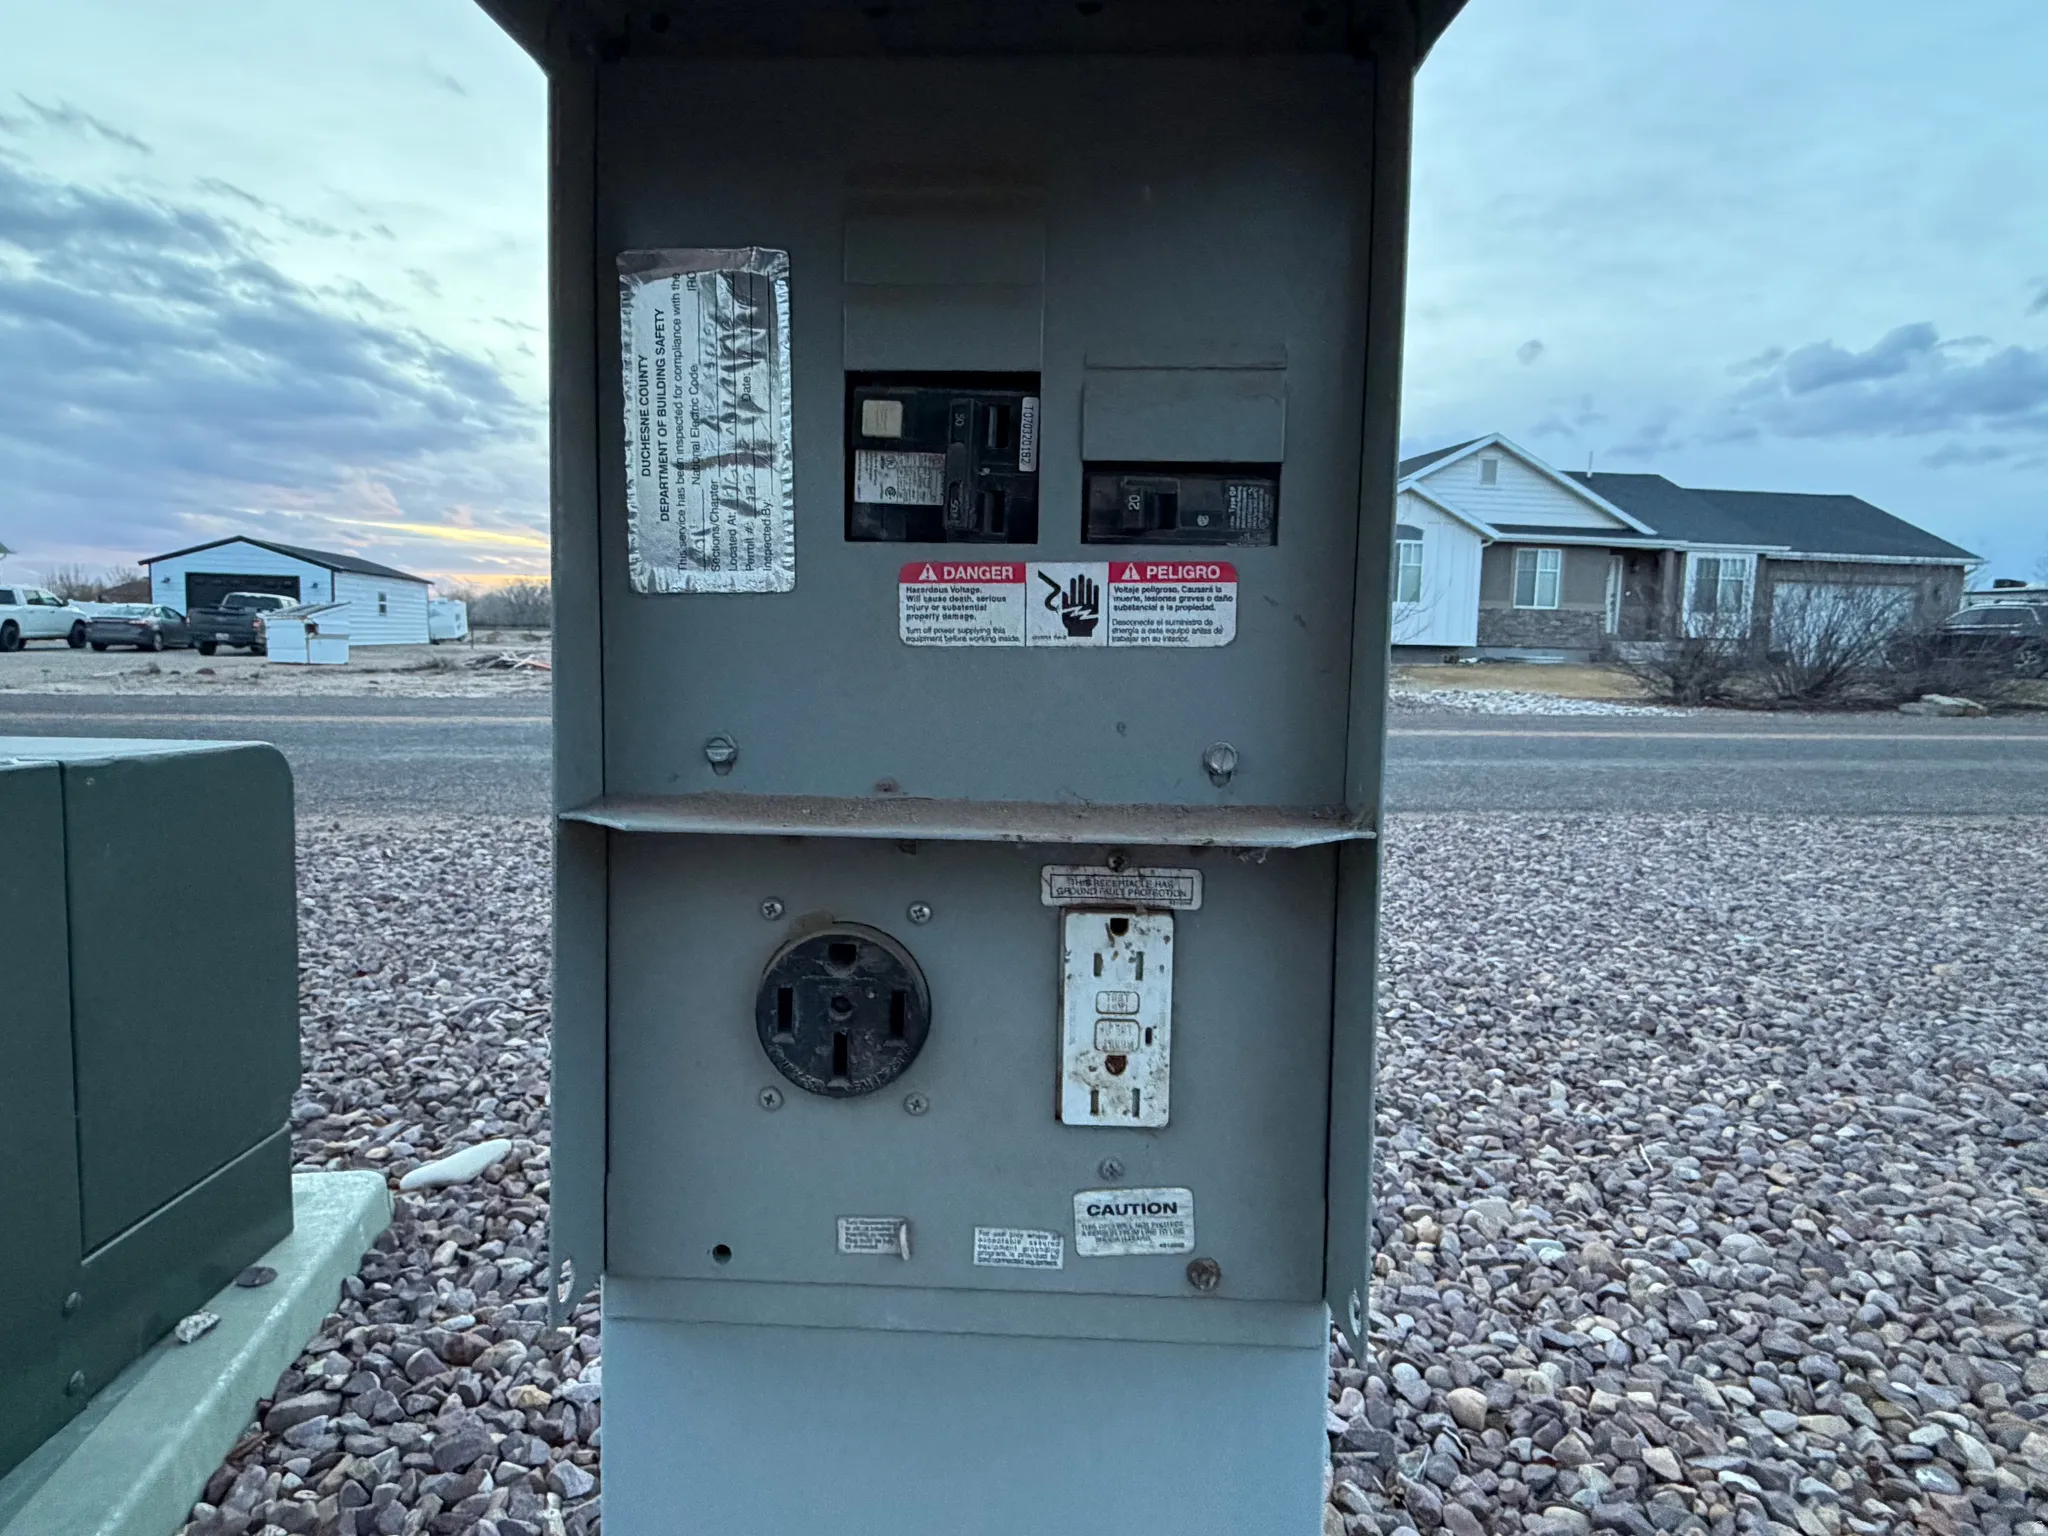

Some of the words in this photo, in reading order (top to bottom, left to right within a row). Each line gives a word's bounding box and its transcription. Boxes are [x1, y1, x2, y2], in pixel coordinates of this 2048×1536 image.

[670, 272, 680, 290] the
[671, 293, 680, 316] with
[654, 308, 665, 356] SAFETY
[672, 318, 684, 382] compliance
[638, 355, 649, 406] COUNTY
[656, 358, 666, 417] BUILDING
[688, 364, 698, 395] Code
[741, 372, 752, 400] Date:
[673, 384, 683, 398] for
[657, 420, 668, 437] OF
[674, 402, 687, 454] inspected
[690, 398, 700, 438] Electric
[640, 410, 652, 477] DUCHESNE
[676, 457, 685, 484] been
[690, 441, 701, 485] National
[658, 440, 670, 522] DEPARTMENT
[676, 488, 686, 506] has
[762, 499, 773, 516] By:
[1128, 494, 1140, 512] 20
[676, 510, 686, 548] service
[710, 480, 721, 572] Sections/Chapter
[727, 529, 738, 572] Located
[744, 538, 755, 572] Permit
[762, 520, 773, 571] Inspected
[677, 550, 688, 571] This
[943, 566, 1014, 580] DANGER
[1146, 565, 1221, 579] PELIGRO
[906, 586, 949, 594] Hazardous
[950, 586, 982, 595] Voltage.
[1113, 586, 1140, 595] Voltaje
[1181, 585, 1214, 593] Causará
[1178, 596, 1205, 604] graves
[1214, 594, 1233, 602] daño
[906, 613, 940, 622] property
[1204, 618, 1213, 626] de
[922, 626, 932, 634] off
[957, 627, 991, 636] supplying
[993, 626, 1006, 634] this
[1165, 627, 1190, 636] equipo
[1192, 626, 1212, 634] antes
[1213, 626, 1223, 634] de
[1056, 887, 1098, 896] GROUND
[1098, 888, 1125, 896] FAULT
[1128, 888, 1188, 898] PROTECTION
[1154, 880, 1174, 889] HAS
[1086, 1202, 1178, 1216] CAUTION
